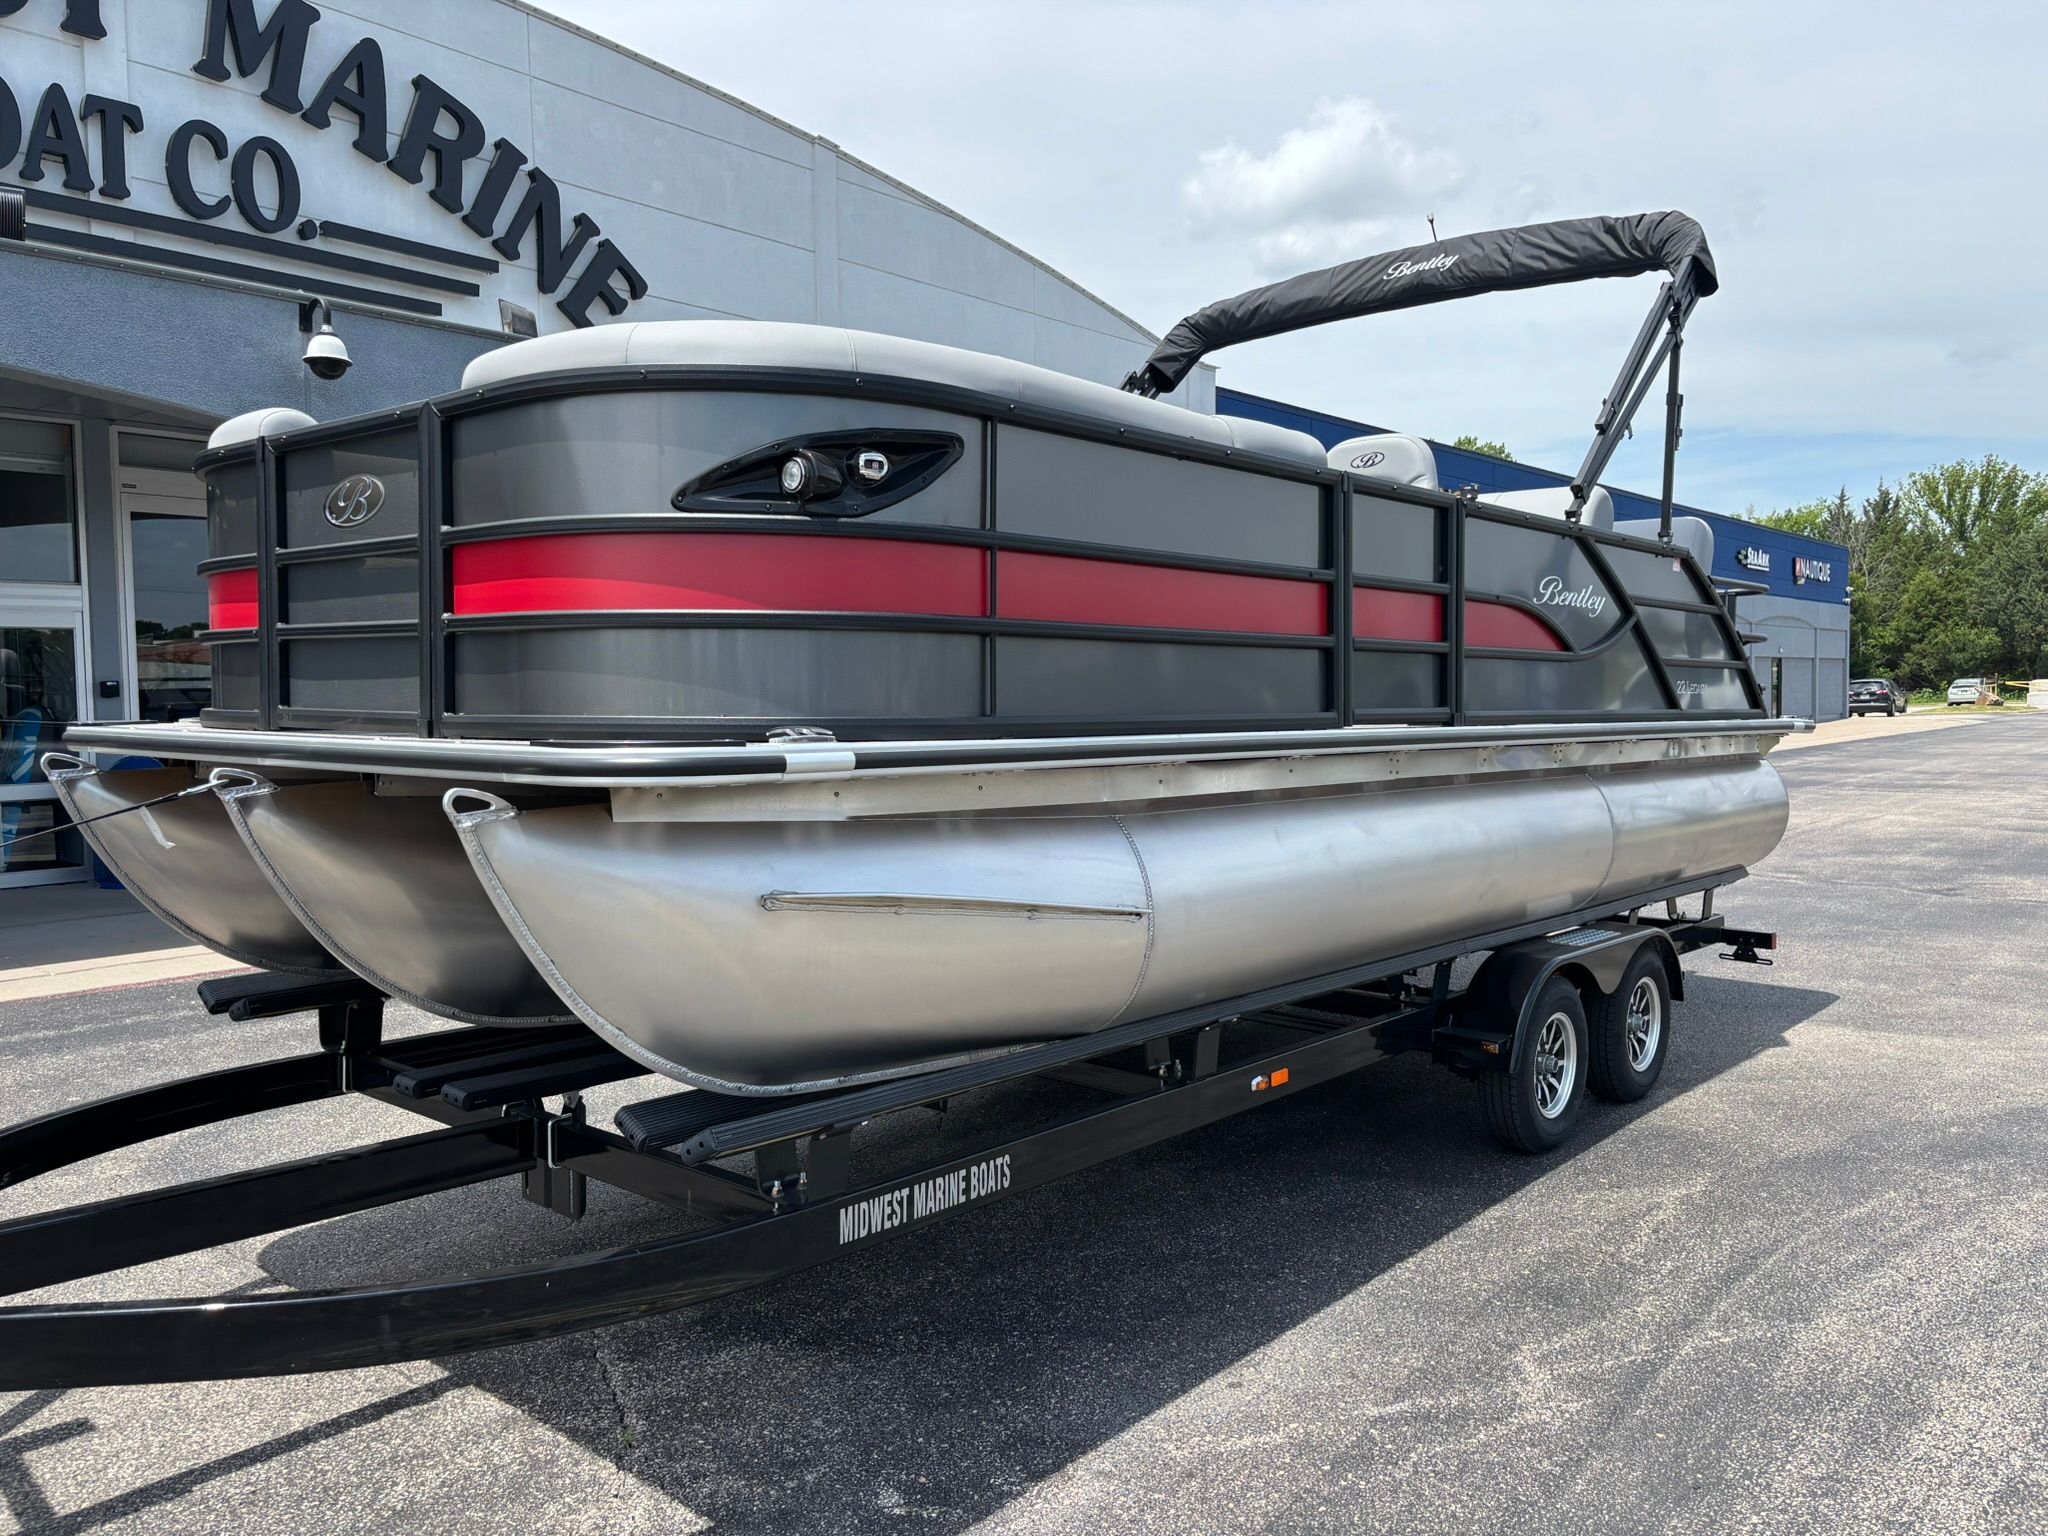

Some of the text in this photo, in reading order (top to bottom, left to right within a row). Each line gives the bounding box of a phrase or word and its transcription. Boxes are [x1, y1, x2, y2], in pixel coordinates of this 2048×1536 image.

[165, 119, 319, 240] CO.
[191, 0, 649, 329] MARINE
[1383, 253, 1460, 280] Bentley
[331, 475, 373, 524] B
[1533, 575, 1606, 618] Bentley
[839, 1154, 1011, 1246] MIDWEST MARINE BOATS
